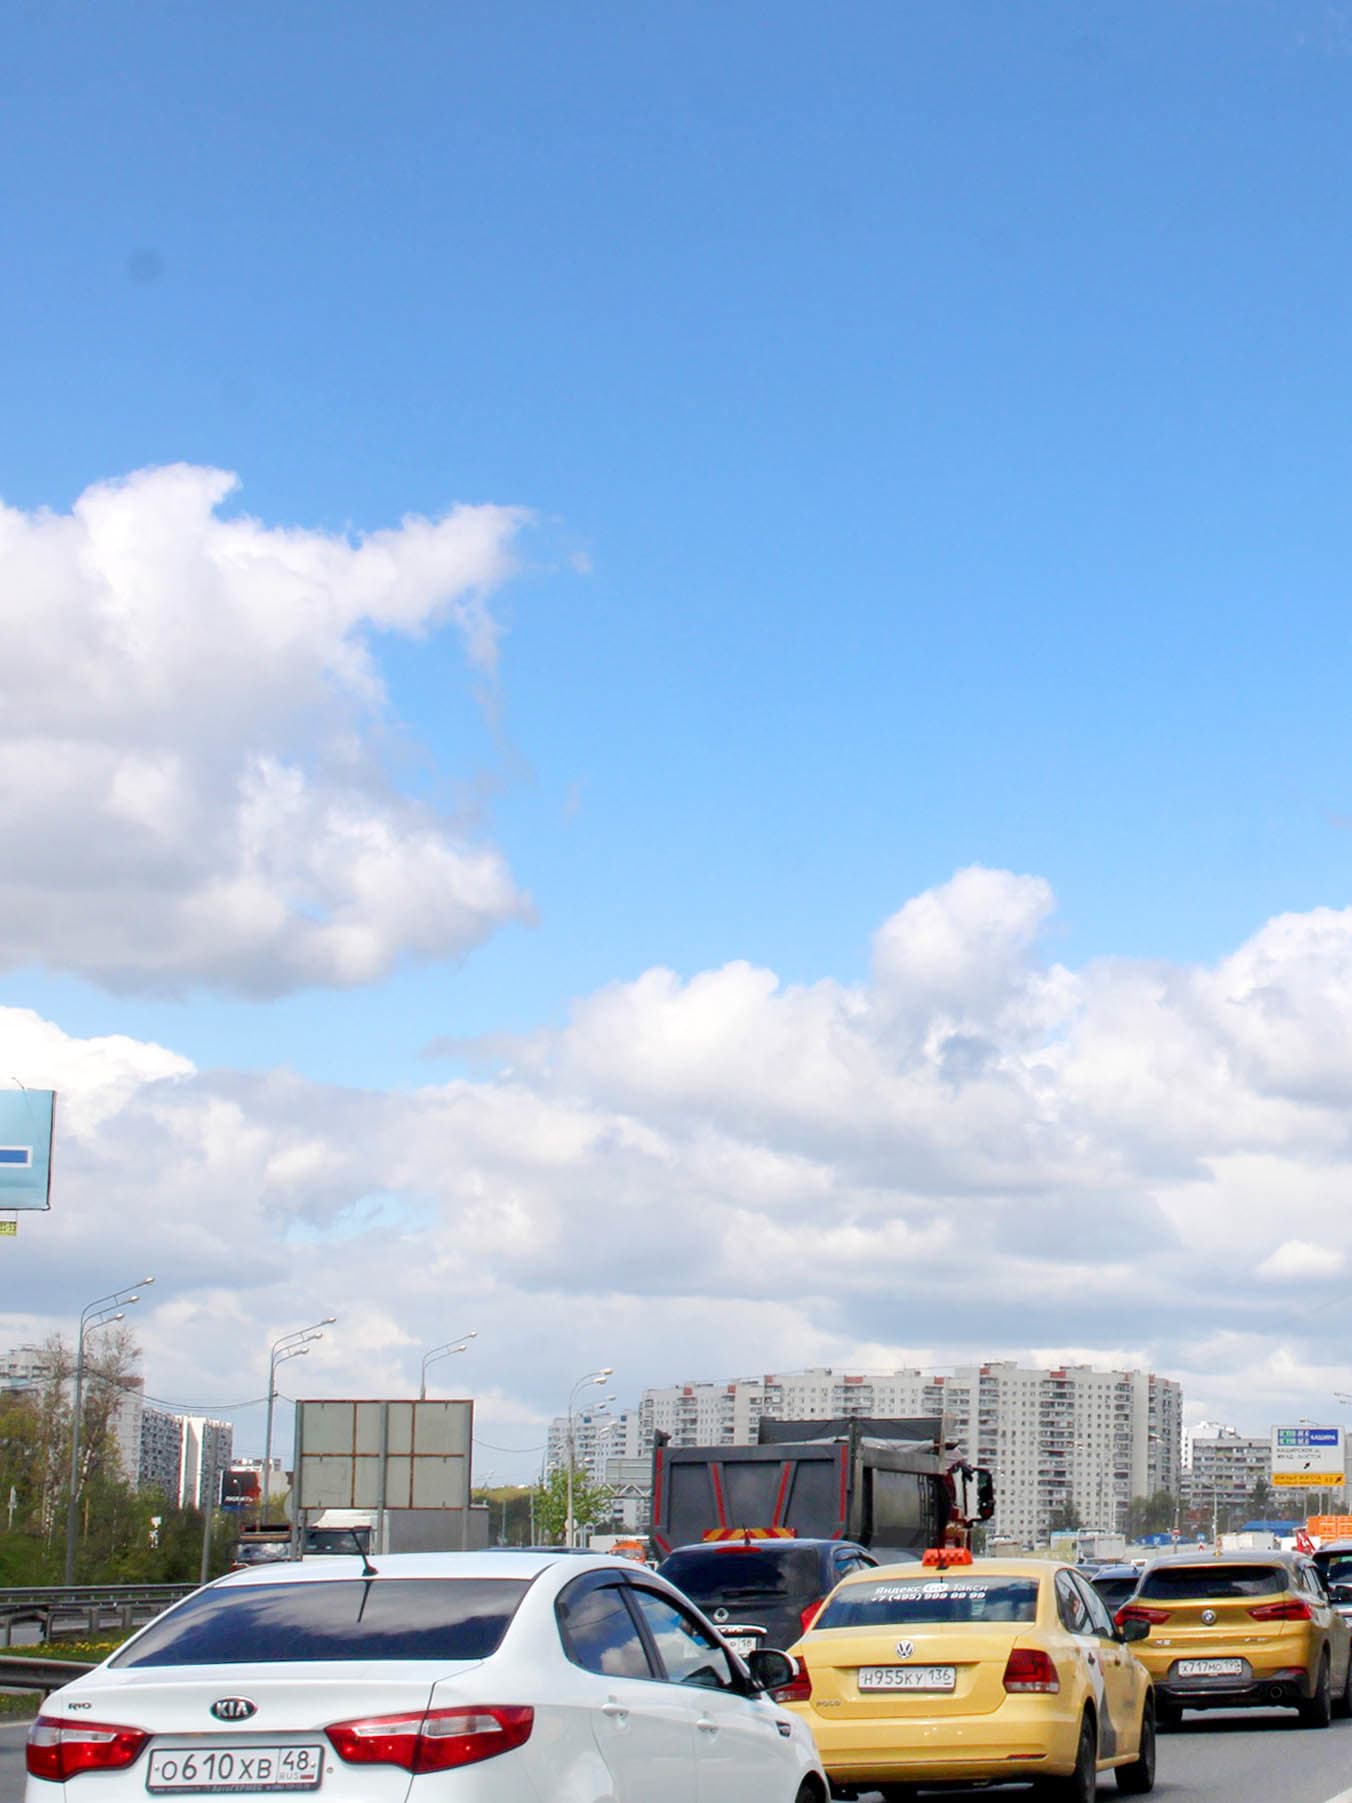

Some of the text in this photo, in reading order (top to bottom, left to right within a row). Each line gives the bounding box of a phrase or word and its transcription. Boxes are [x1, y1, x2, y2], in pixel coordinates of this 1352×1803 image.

[874, 1585, 921, 1595] Яндекс
[953, 1583, 989, 1592] Такси
[928, 1668, 952, 1681] 136
[216, 1701, 249, 1717] KIA
[282, 1750, 310, 1771] 48
[280, 1772, 299, 1780] RUS
